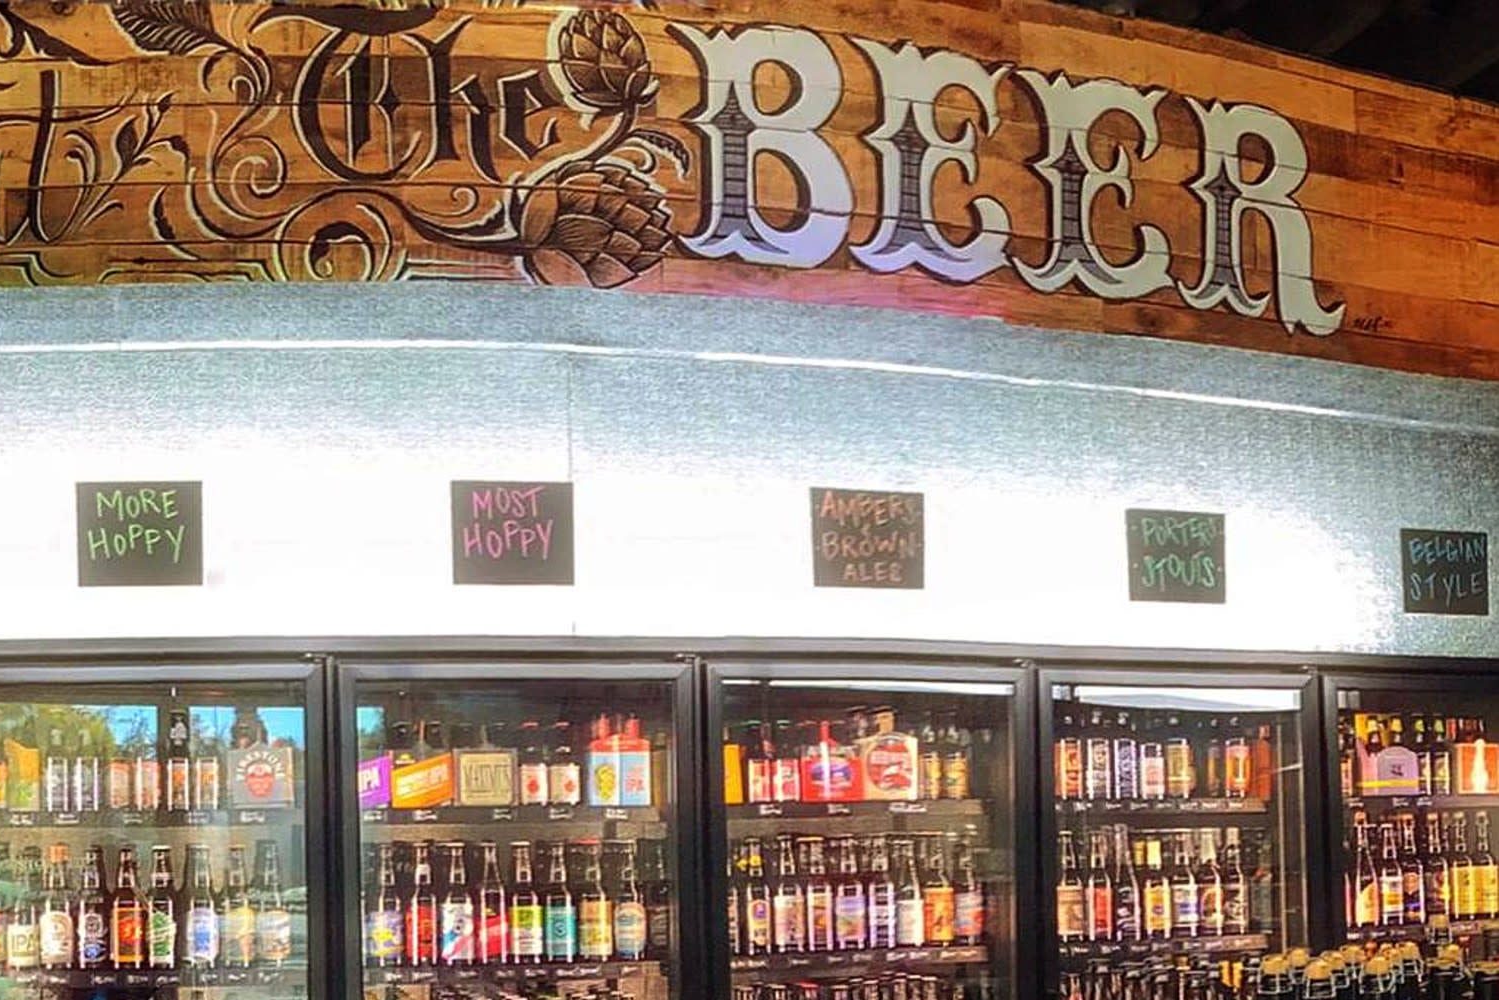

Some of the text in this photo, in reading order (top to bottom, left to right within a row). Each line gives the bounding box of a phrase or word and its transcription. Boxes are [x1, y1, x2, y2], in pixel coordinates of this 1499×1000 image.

[290, 13, 564, 183] The
[669, 22, 1348, 338] BEER
[95, 488, 179, 521] MORE
[471, 484, 544, 519] MOST
[86, 523, 186, 564] HOPPY
[462, 519, 554, 561] HOPPY
[821, 530, 918, 562] BROWN
[1409, 537, 1487, 566] BELGIAN
[843, 561, 903, 582] ALES
[1409, 571, 1485, 609] STYLE
